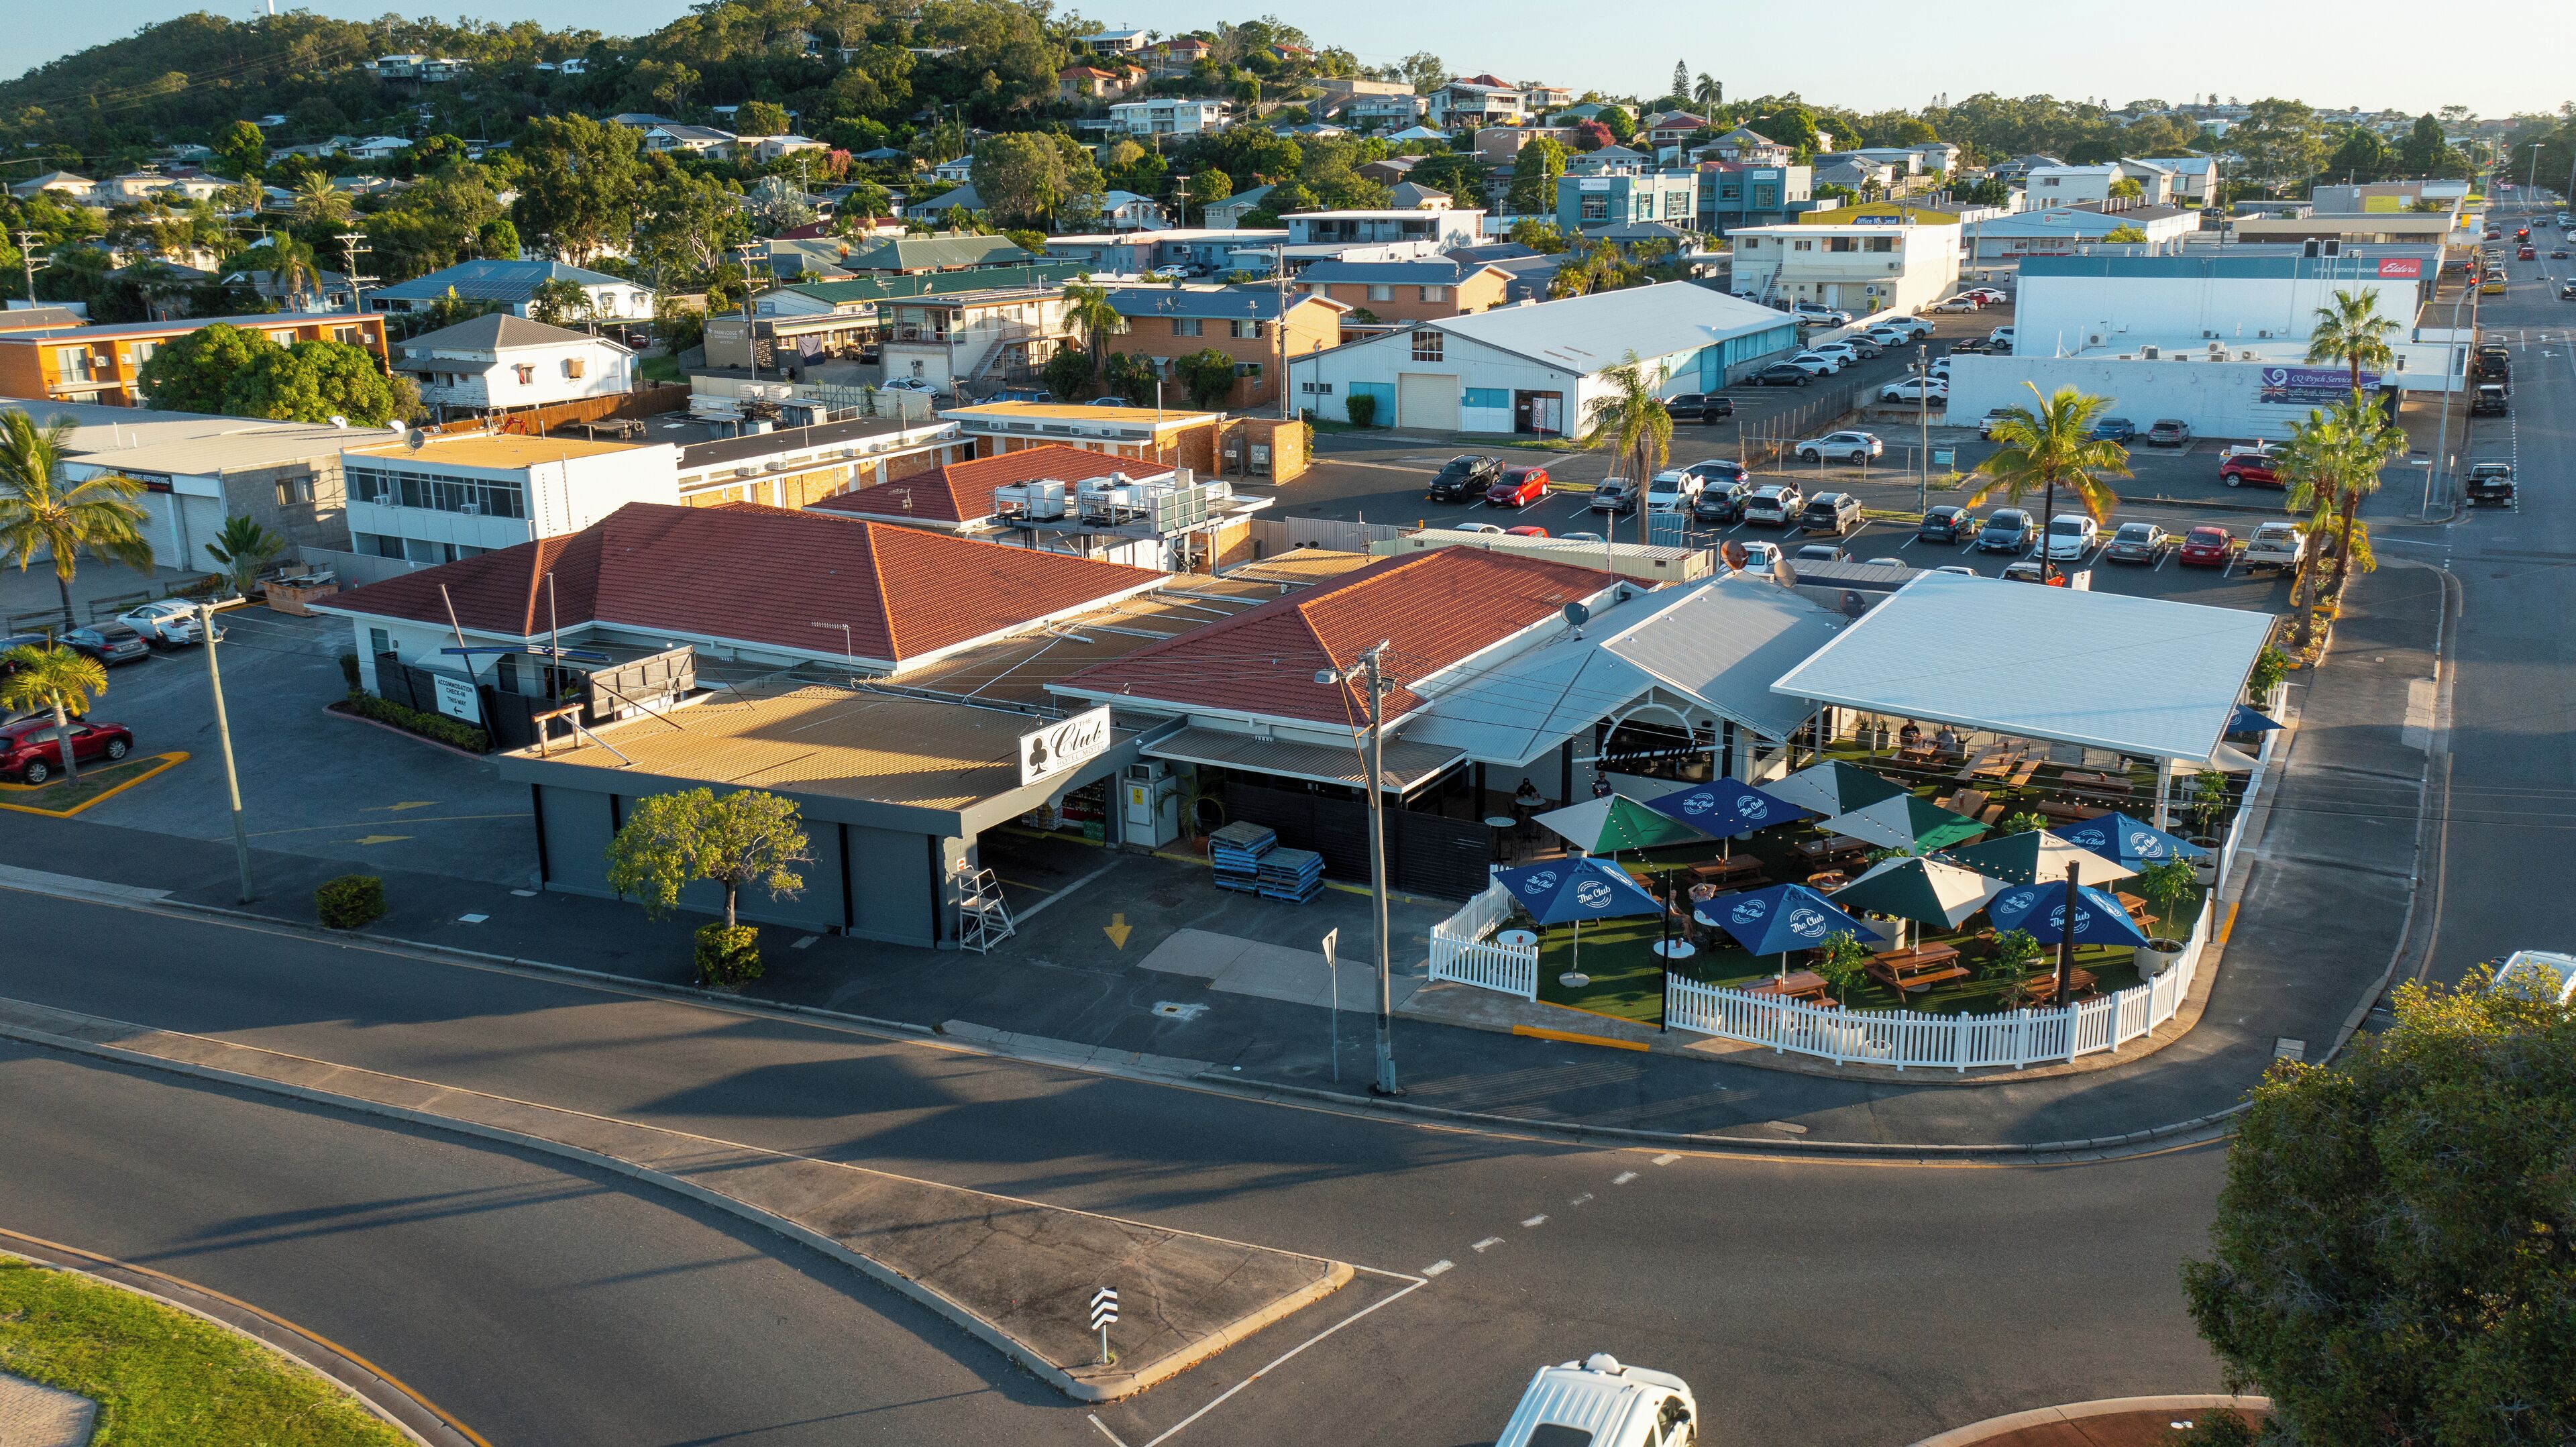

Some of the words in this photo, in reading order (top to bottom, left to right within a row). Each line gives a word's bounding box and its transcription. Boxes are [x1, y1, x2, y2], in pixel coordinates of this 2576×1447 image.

[2382, 263, 2416, 273] Elders
[2292, 374, 2304, 384] CQ
[2305, 374, 2325, 384] Psych
[438, 679, 473, 693] ACCOMMODATION
[446, 688, 466, 697] CHECK-IN
[1079, 718, 1092, 727] THE
[1051, 720, 1106, 758] Club
[1739, 807, 1752, 816] The
[1751, 799, 1764, 810] Club
[2086, 838, 2106, 846] Club
[2135, 845, 2147, 855] The
[2145, 835, 2157, 848] Club
[1527, 876, 1540, 885] The
[1538, 880, 1554, 888] Club
[1577, 894, 1594, 904] The
[1593, 886, 1611, 897] Club
[1733, 905, 1748, 913] The
[1746, 909, 1764, 918] Club
[2074, 912, 2090, 922] lub
[1790, 922, 1808, 933] The
[1807, 914, 1825, 926] Club
